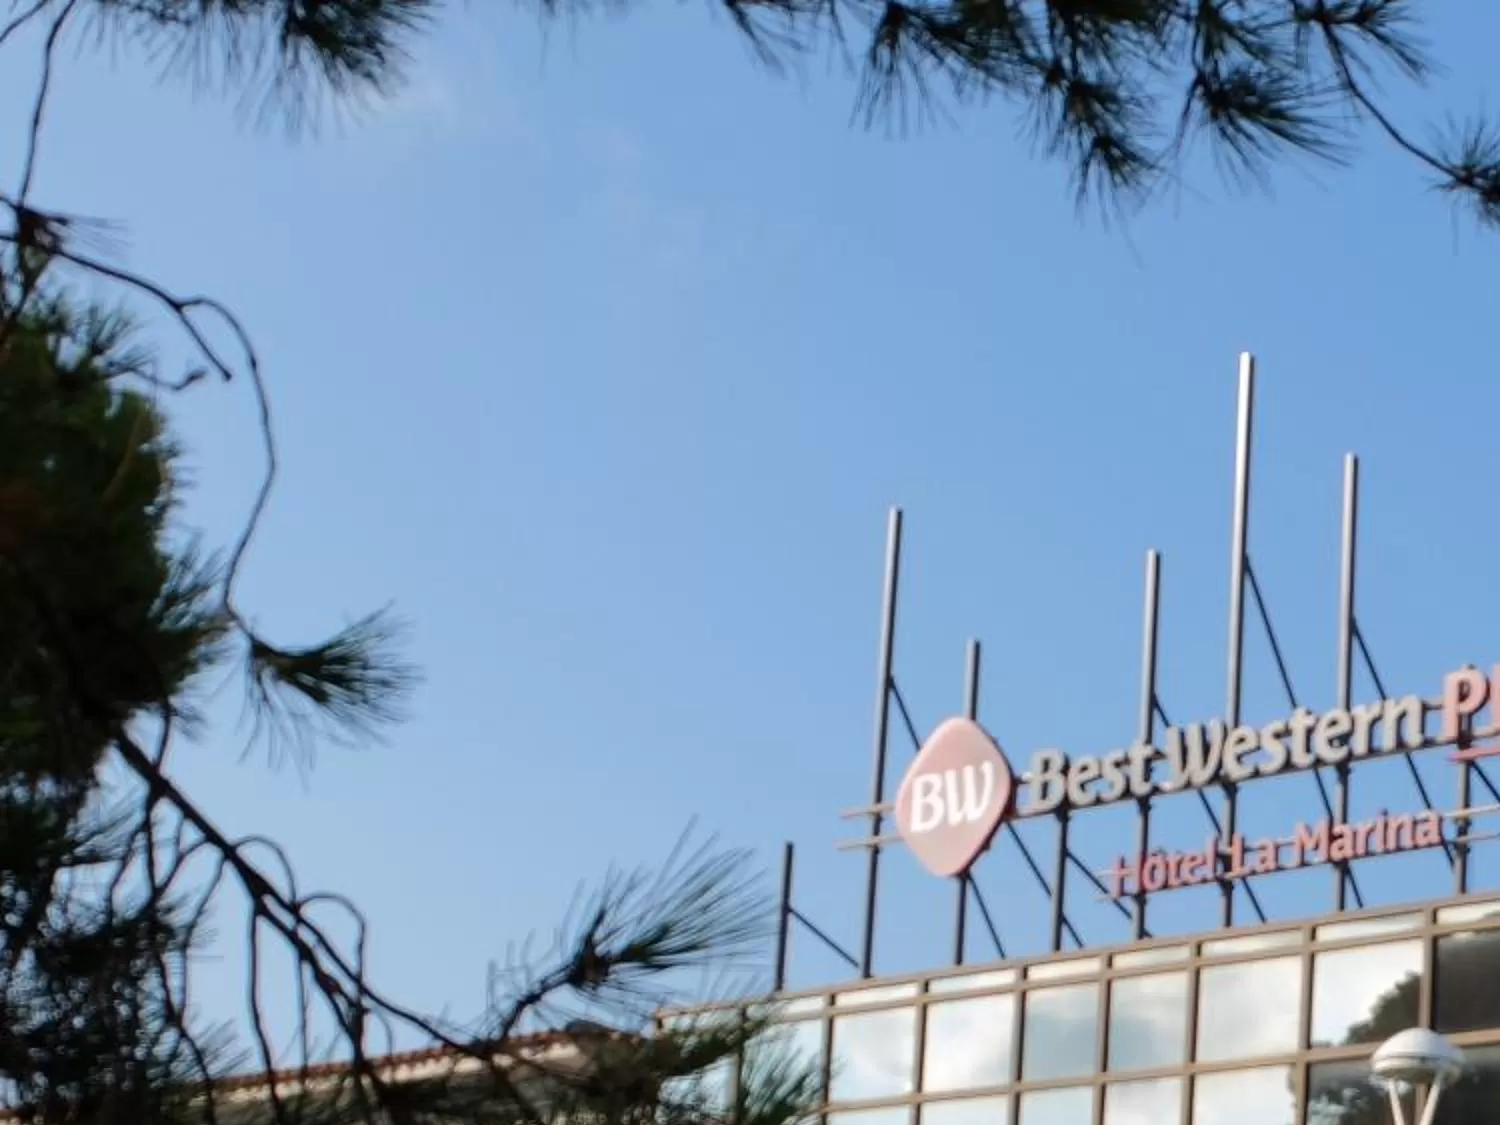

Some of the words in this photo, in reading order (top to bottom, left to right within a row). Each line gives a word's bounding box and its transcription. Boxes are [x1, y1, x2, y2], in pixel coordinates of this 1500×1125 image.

[1026, 741, 1154, 810] Best
[1159, 696, 1424, 790] Western
[910, 760, 995, 832] BW
[1226, 833, 1283, 878] La
[1291, 811, 1443, 867] Marina
